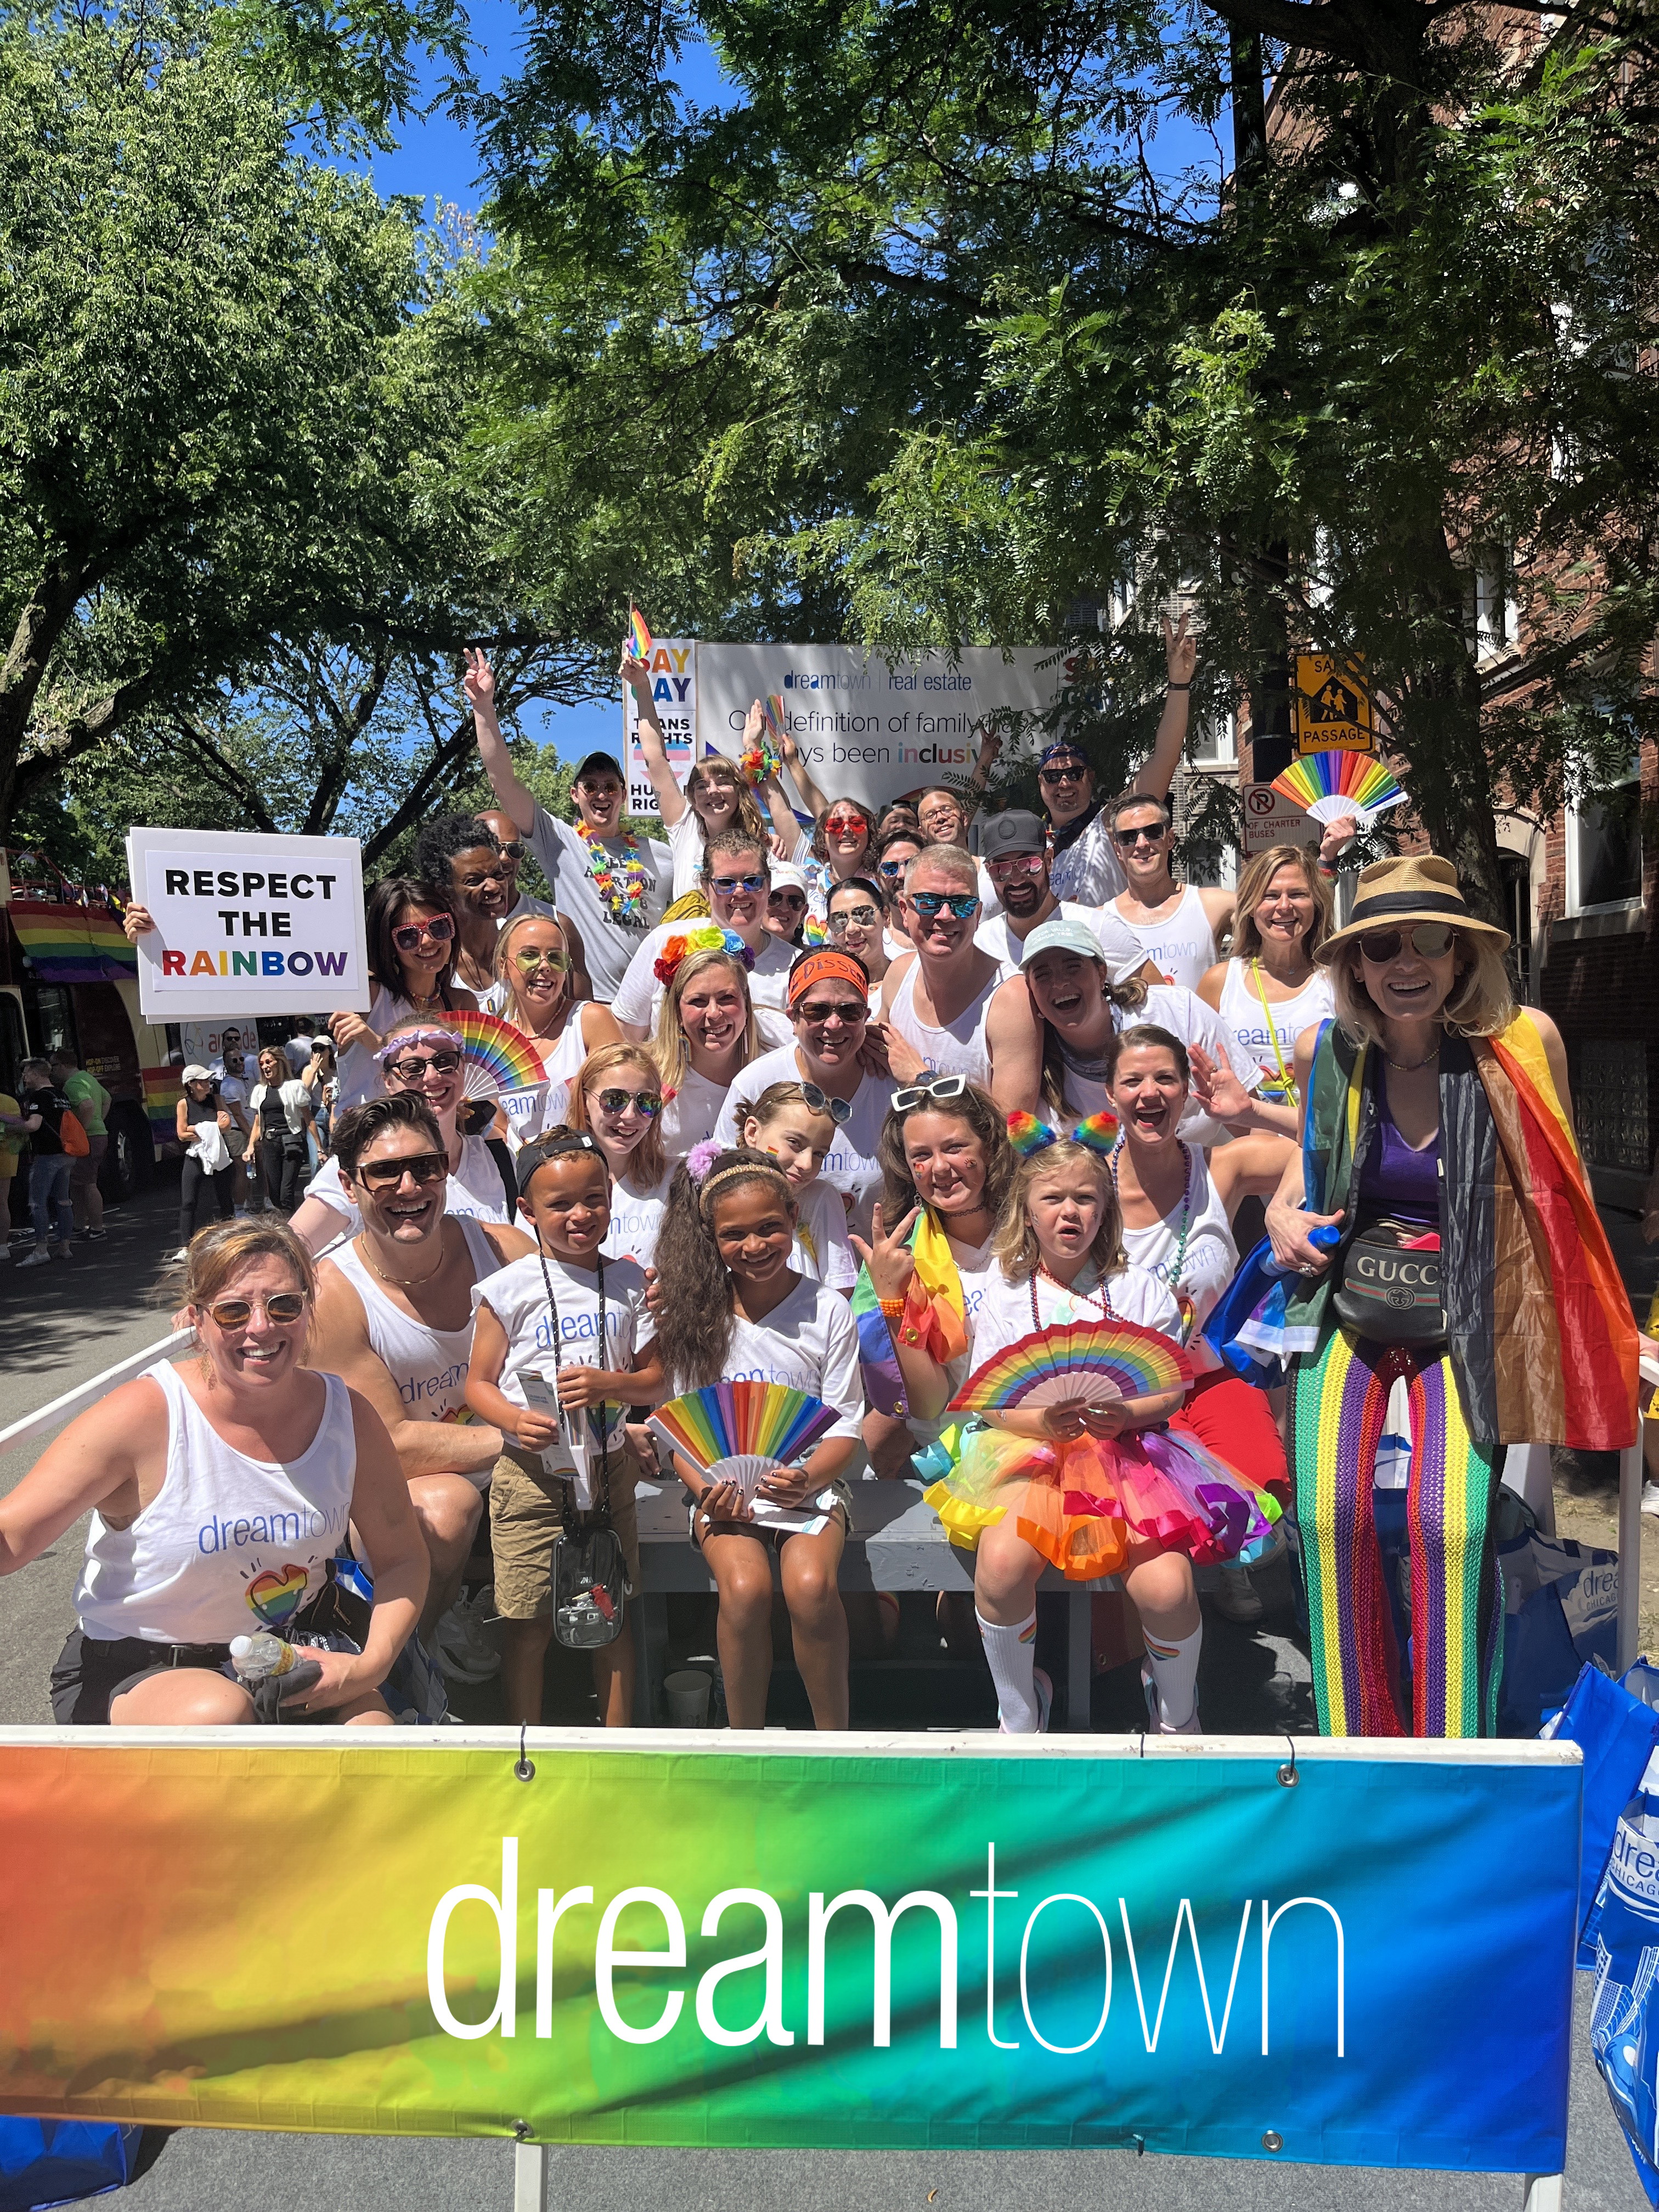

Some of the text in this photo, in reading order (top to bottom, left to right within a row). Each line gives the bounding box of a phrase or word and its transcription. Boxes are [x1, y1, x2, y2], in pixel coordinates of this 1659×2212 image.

[641, 648, 691, 674] AY
[631, 678, 692, 702] AY
[784, 670, 972, 691] dreamtown real estate
[785, 711, 879, 732] definition
[888, 712, 910, 733] of
[916, 712, 984, 738] family
[1304, 728, 1365, 743] PASSAGE
[833, 743, 890, 763] been
[1249, 830, 1275, 839] BUSES
[1263, 819, 1301, 830] CHARTER
[166, 870, 336, 899] RESPECT
[218, 911, 291, 936] THE
[603, 911, 650, 929] LEGAL
[162, 950, 348, 976] RAINBOW
[1357, 1256, 1438, 1285] GUCC
[399, 1363, 469, 1404] dream
[1611, 1857, 1659, 1895] CHICAG
[427, 1837, 1344, 2057] dreamtown
